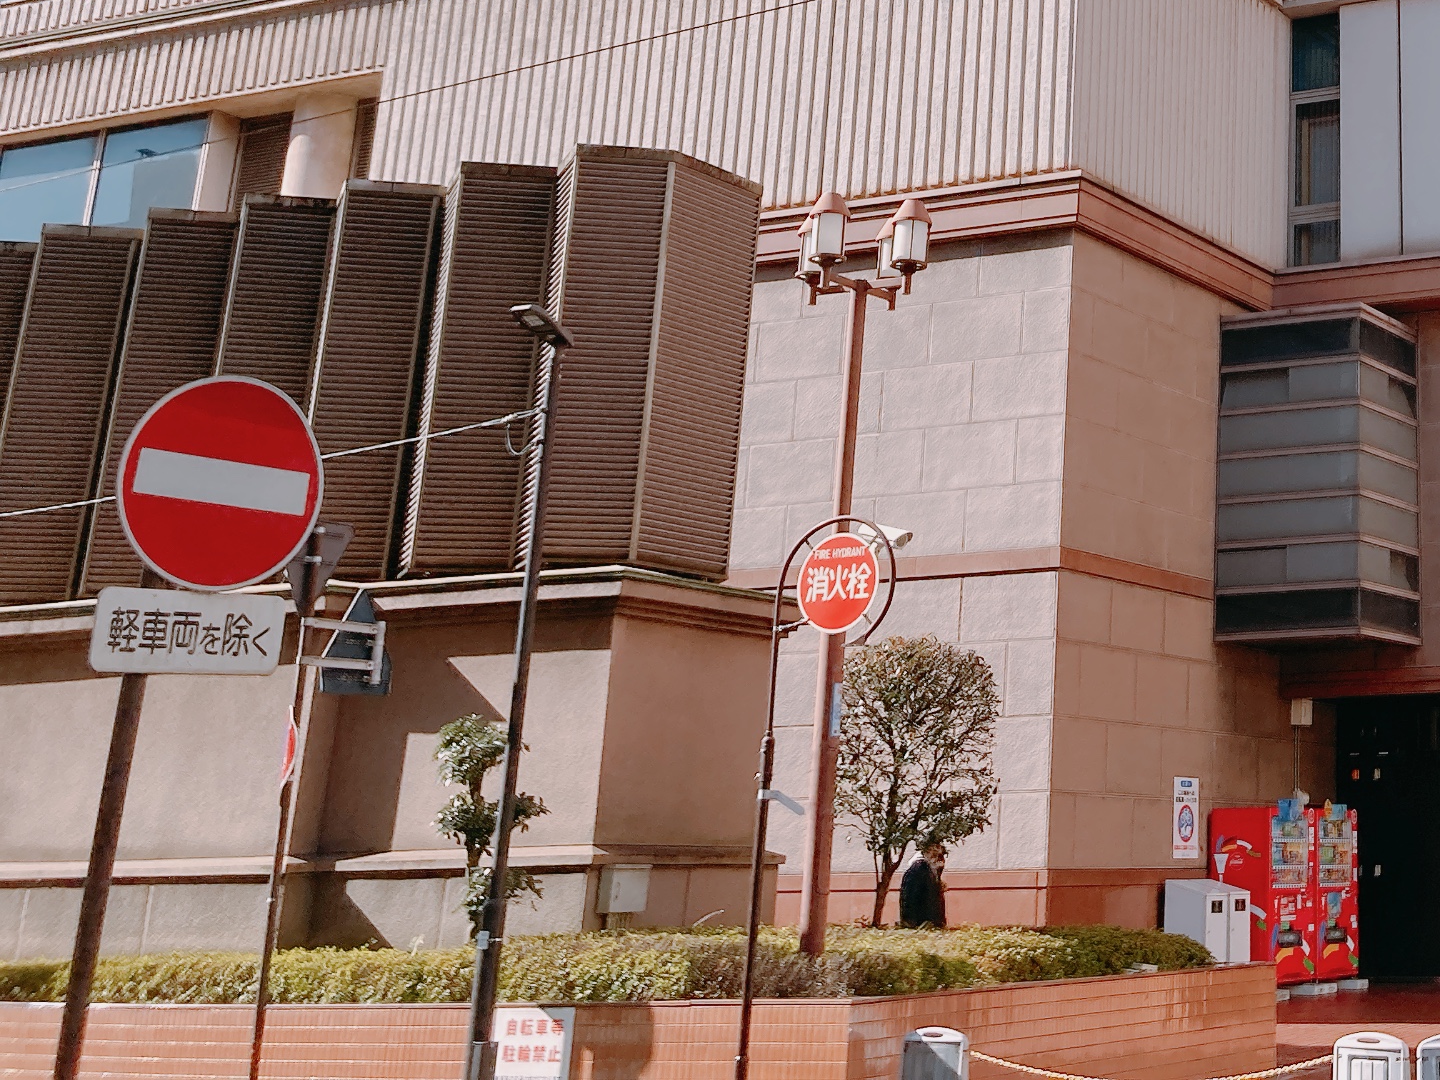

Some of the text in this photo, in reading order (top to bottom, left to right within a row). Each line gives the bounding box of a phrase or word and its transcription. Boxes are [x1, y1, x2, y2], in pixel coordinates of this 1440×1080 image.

[814, 545, 867, 561] FIRE HYDRANT
[805, 562, 872, 603] 消火栓
[107, 606, 271, 657] 軽車両を除く
[502, 1044, 561, 1063] 駐輪禁止
